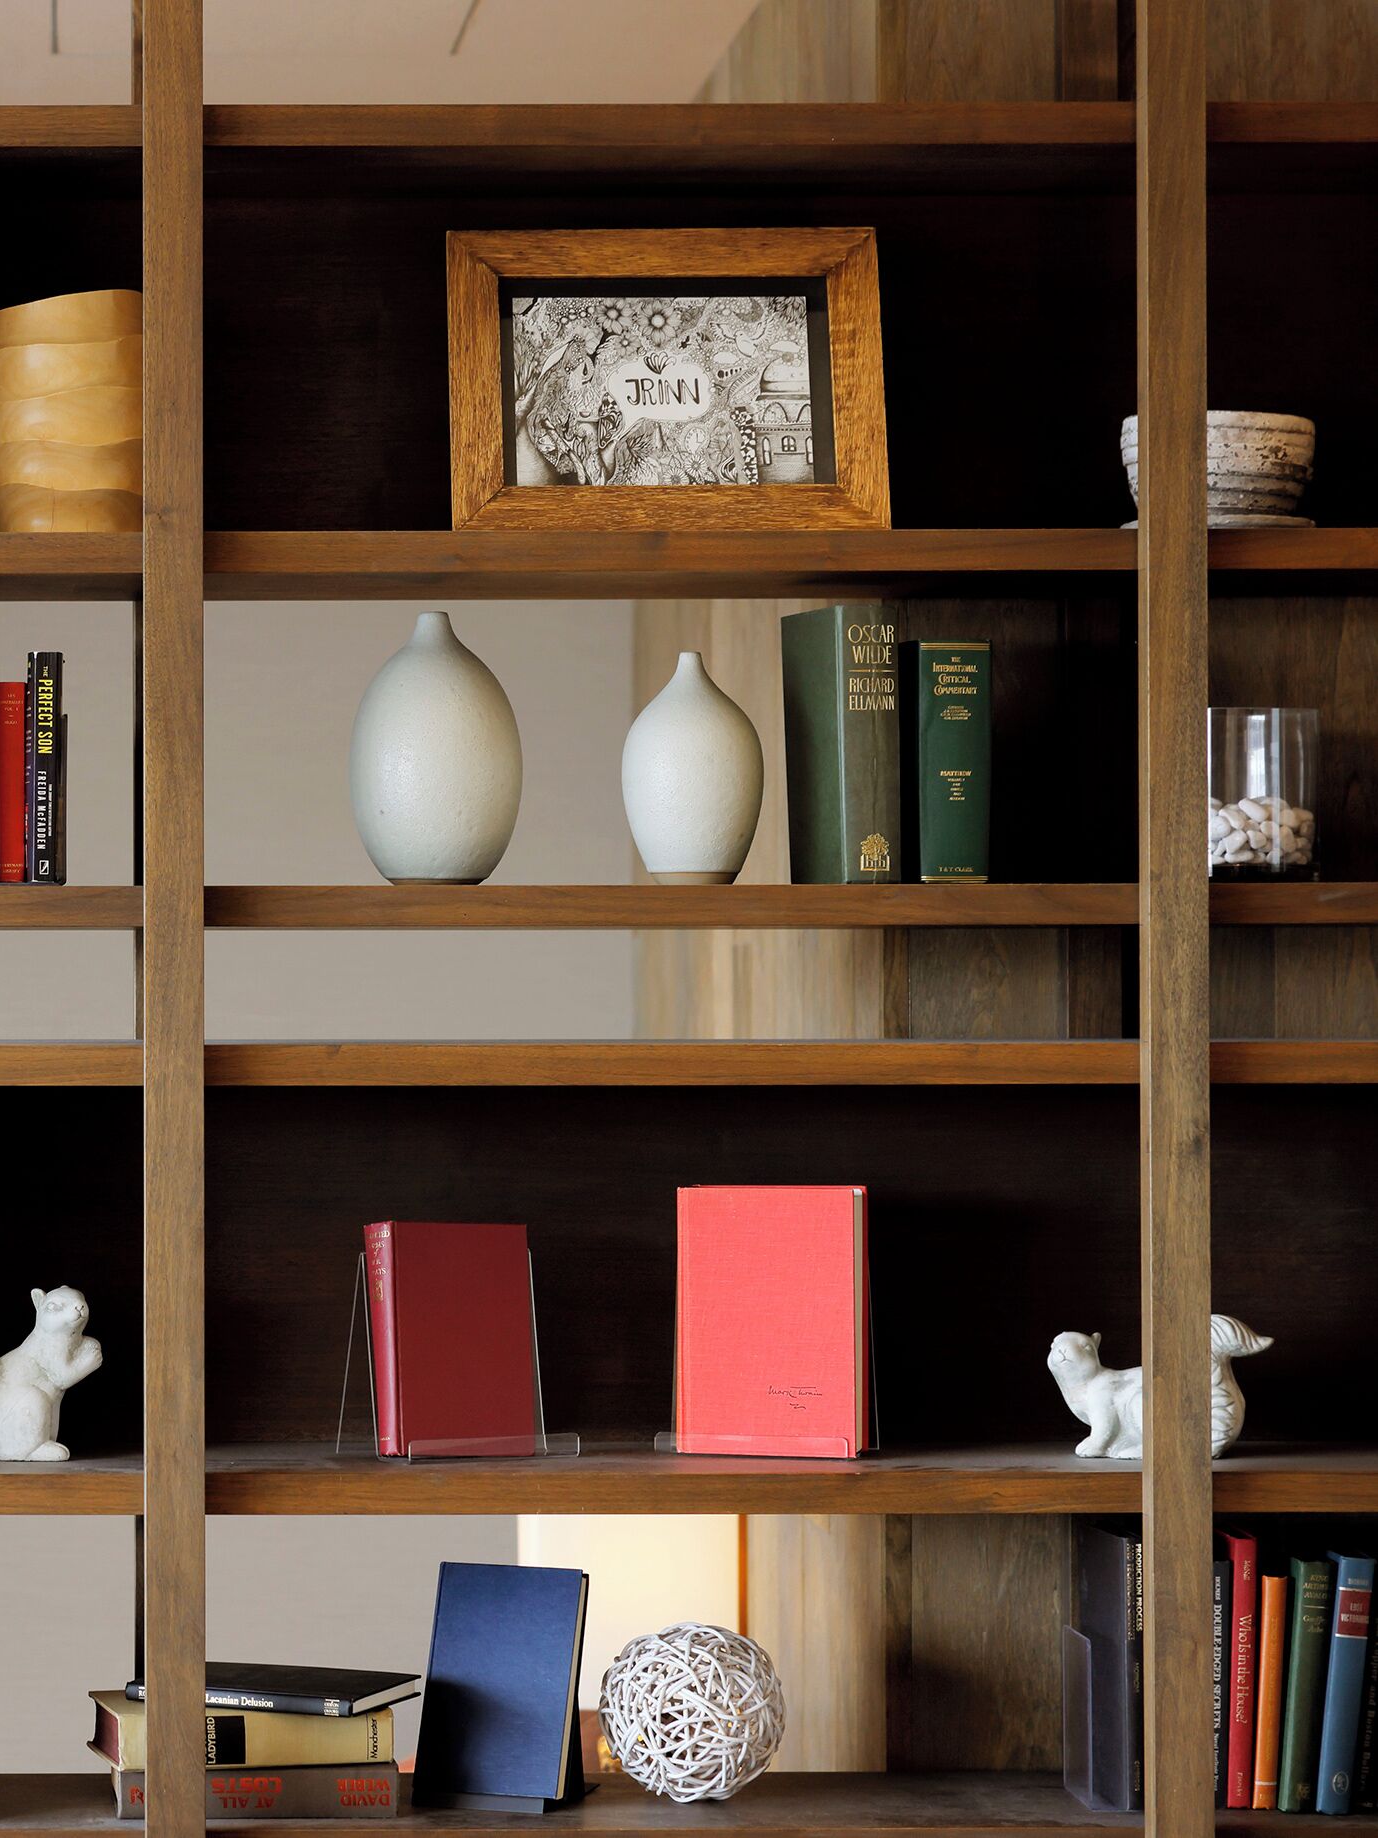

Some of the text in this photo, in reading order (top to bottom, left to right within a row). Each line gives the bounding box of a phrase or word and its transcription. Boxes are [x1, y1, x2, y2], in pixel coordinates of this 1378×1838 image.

[848, 624, 895, 644] OSCAR
[852, 645, 893, 664] WILDE
[849, 677, 895, 693] RICHARD
[38, 679, 53, 728] PERFECT
[849, 695, 895, 711] ELLMANN
[37, 731, 53, 754] SON
[37, 770, 46, 850] FREIDA McFADDEN
[1135, 1543, 1143, 1632] PRODUCTION PROCESS
[1213, 1604, 1222, 1681] DOUBLE-EDGED
[1235, 1614, 1252, 1724] Who Is in the House?
[205, 1693, 274, 1708] Lacanian Delusion
[1213, 1684, 1222, 1729] SECRETS
[206, 1717, 216, 1764] LADYBIRD
[210, 1776, 282, 1793] COSTS
[337, 1778, 391, 1792] WEBER
[219, 1796, 275, 1808] AT ALL
[340, 1794, 391, 1806] DAVID
